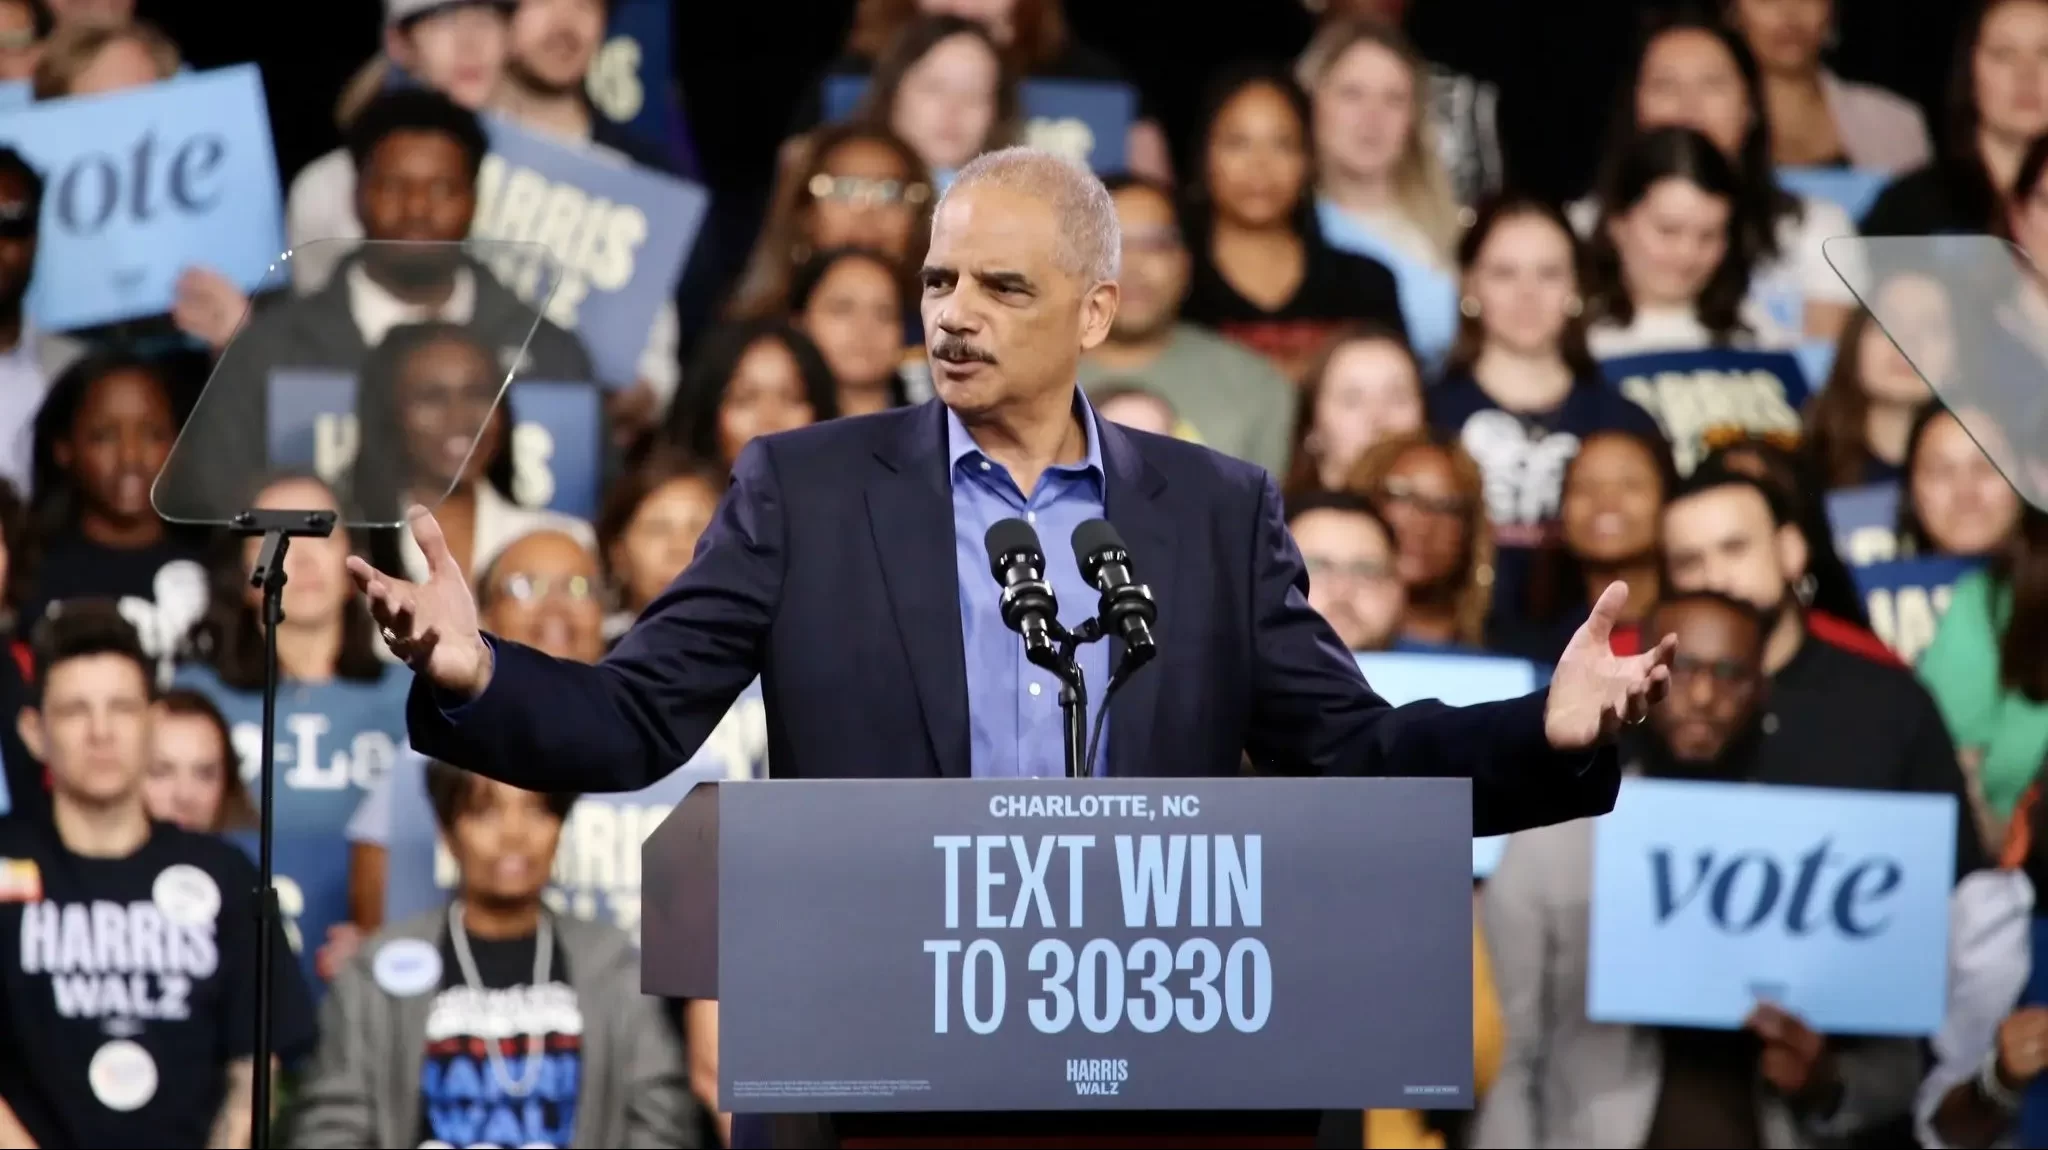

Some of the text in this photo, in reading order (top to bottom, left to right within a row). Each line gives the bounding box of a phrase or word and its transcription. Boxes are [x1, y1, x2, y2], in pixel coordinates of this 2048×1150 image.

[52, 126, 225, 238] ote
[989, 795, 1200, 821] CHARLOTTE, NC
[933, 834, 1262, 929] TEXT WIN
[1645, 833, 1905, 943] vote
[20, 897, 220, 980] HARRIS
[52, 973, 193, 1021] WALZ
[923, 936, 1272, 1035] TO 30330
[1066, 1058, 1129, 1081] HARRIS
[1075, 1081, 1120, 1096] WALZ
